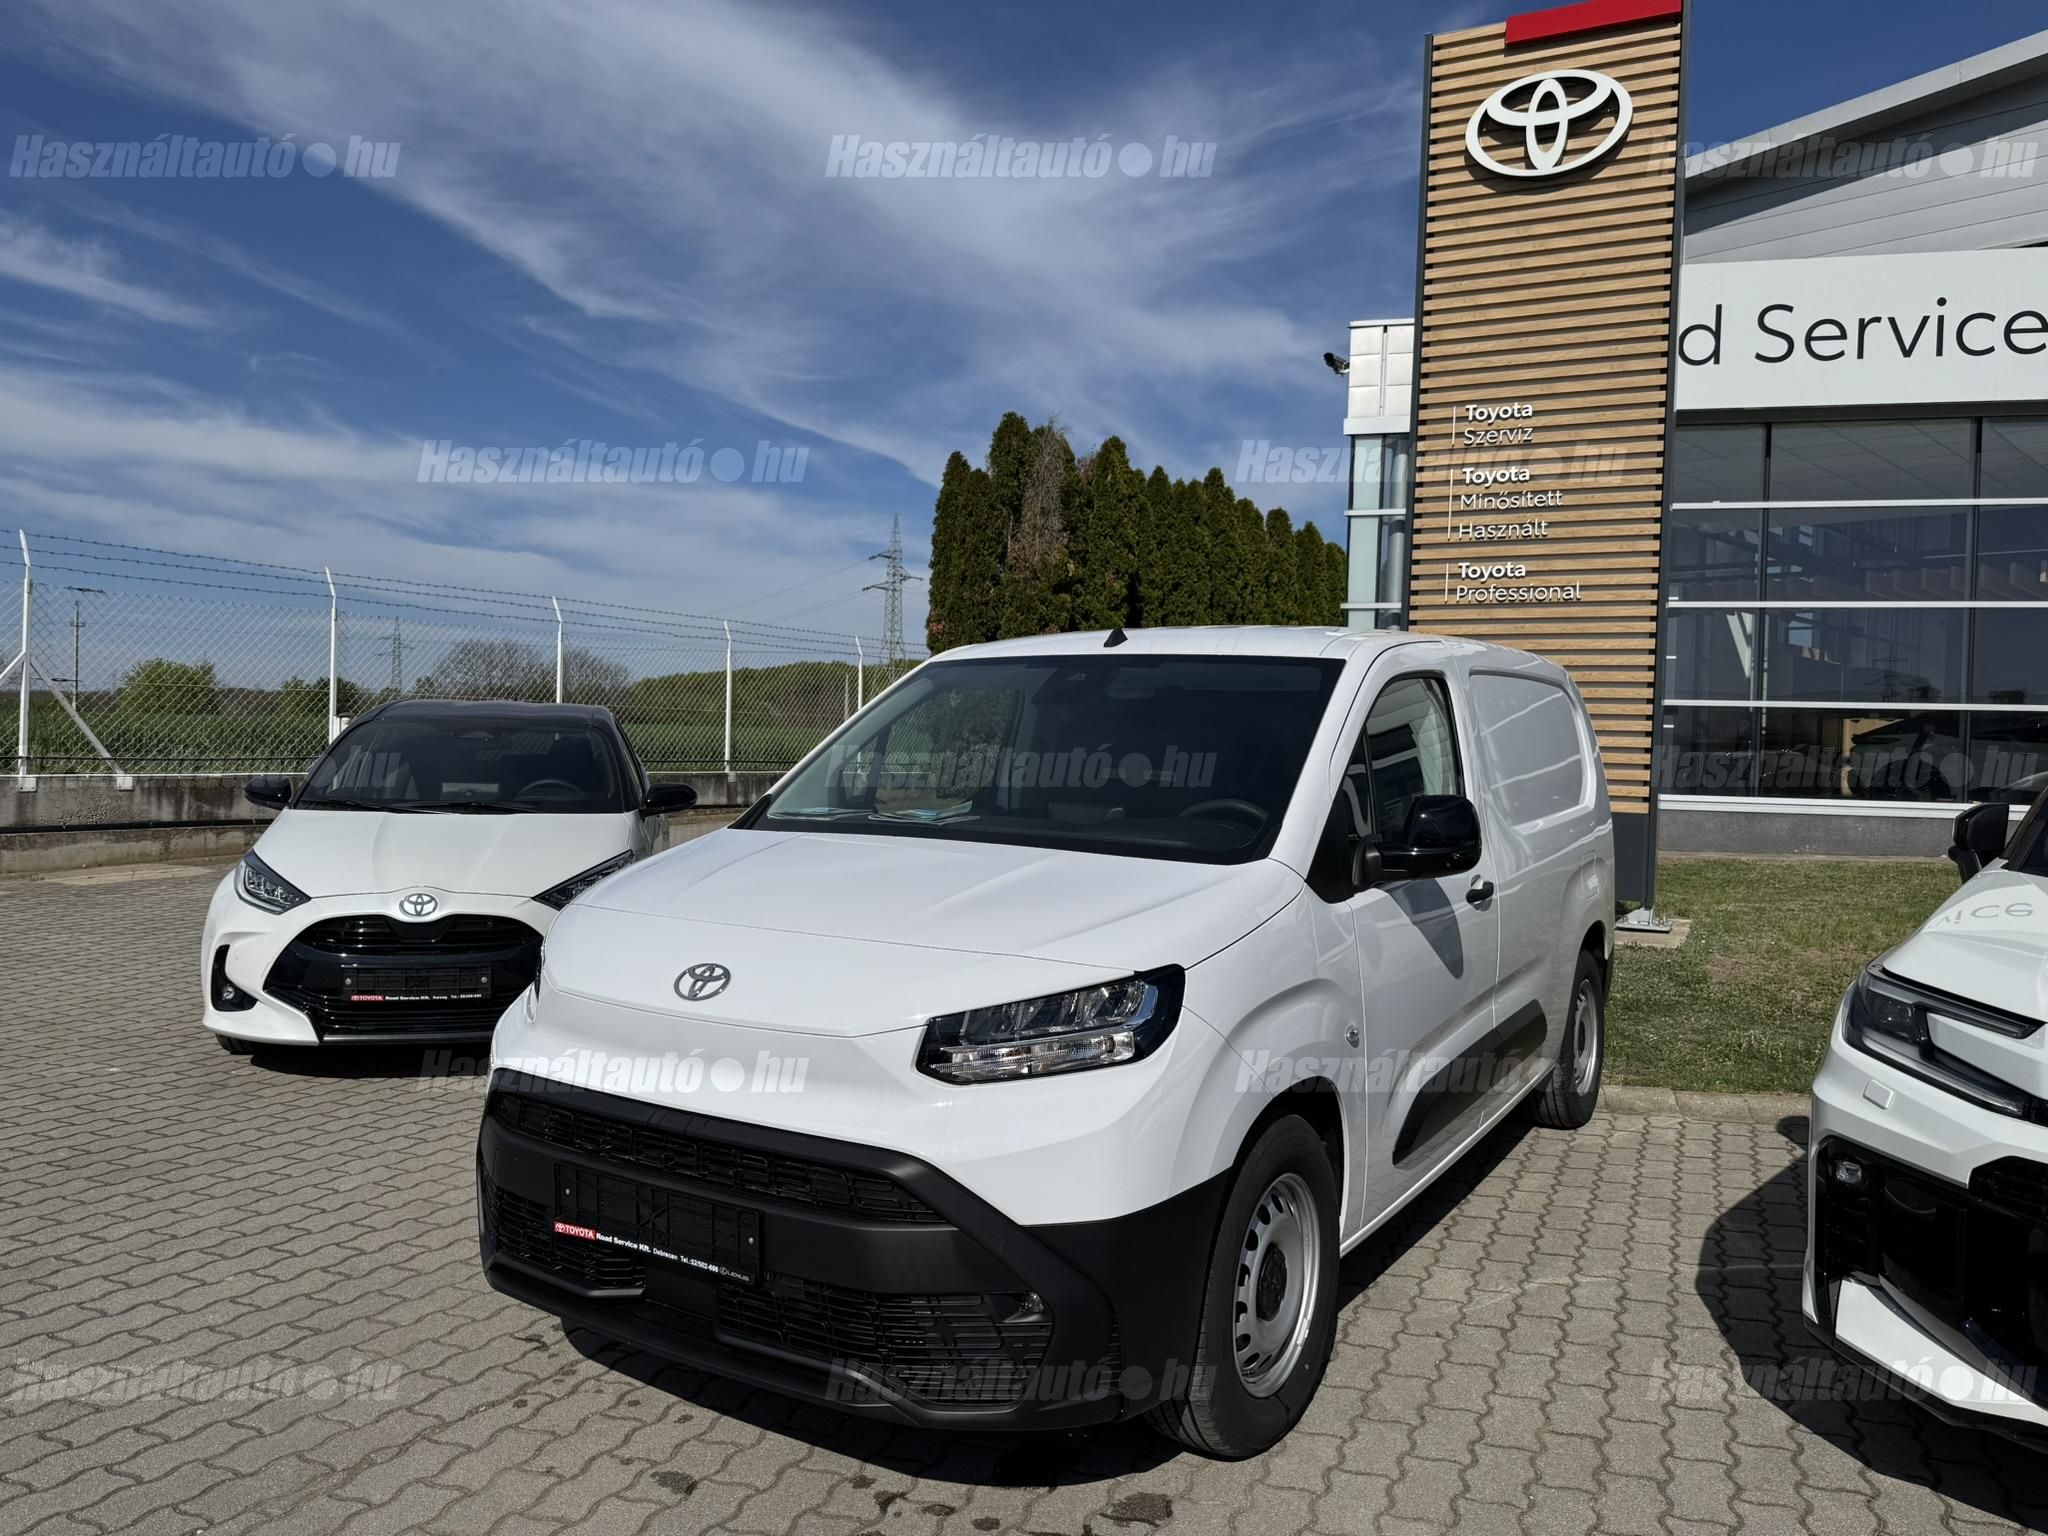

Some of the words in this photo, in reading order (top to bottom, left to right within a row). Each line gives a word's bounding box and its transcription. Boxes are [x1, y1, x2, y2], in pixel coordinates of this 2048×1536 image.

[1678, 304, 1723, 366] d
[1754, 297, 2048, 363] Service
[1465, 402, 1533, 424] Toyota
[1463, 424, 1534, 446] Szerviz
[1462, 465, 1530, 487] Toyota
[1460, 489, 1563, 511] Minősített
[1459, 518, 1548, 538] Használt
[1458, 561, 1526, 582] Toyota
[1456, 581, 1582, 602] Professional
[565, 1224, 594, 1239] TOYOTA
[596, 1232, 613, 1243] Road
[613, 1237, 638, 1249] Service
